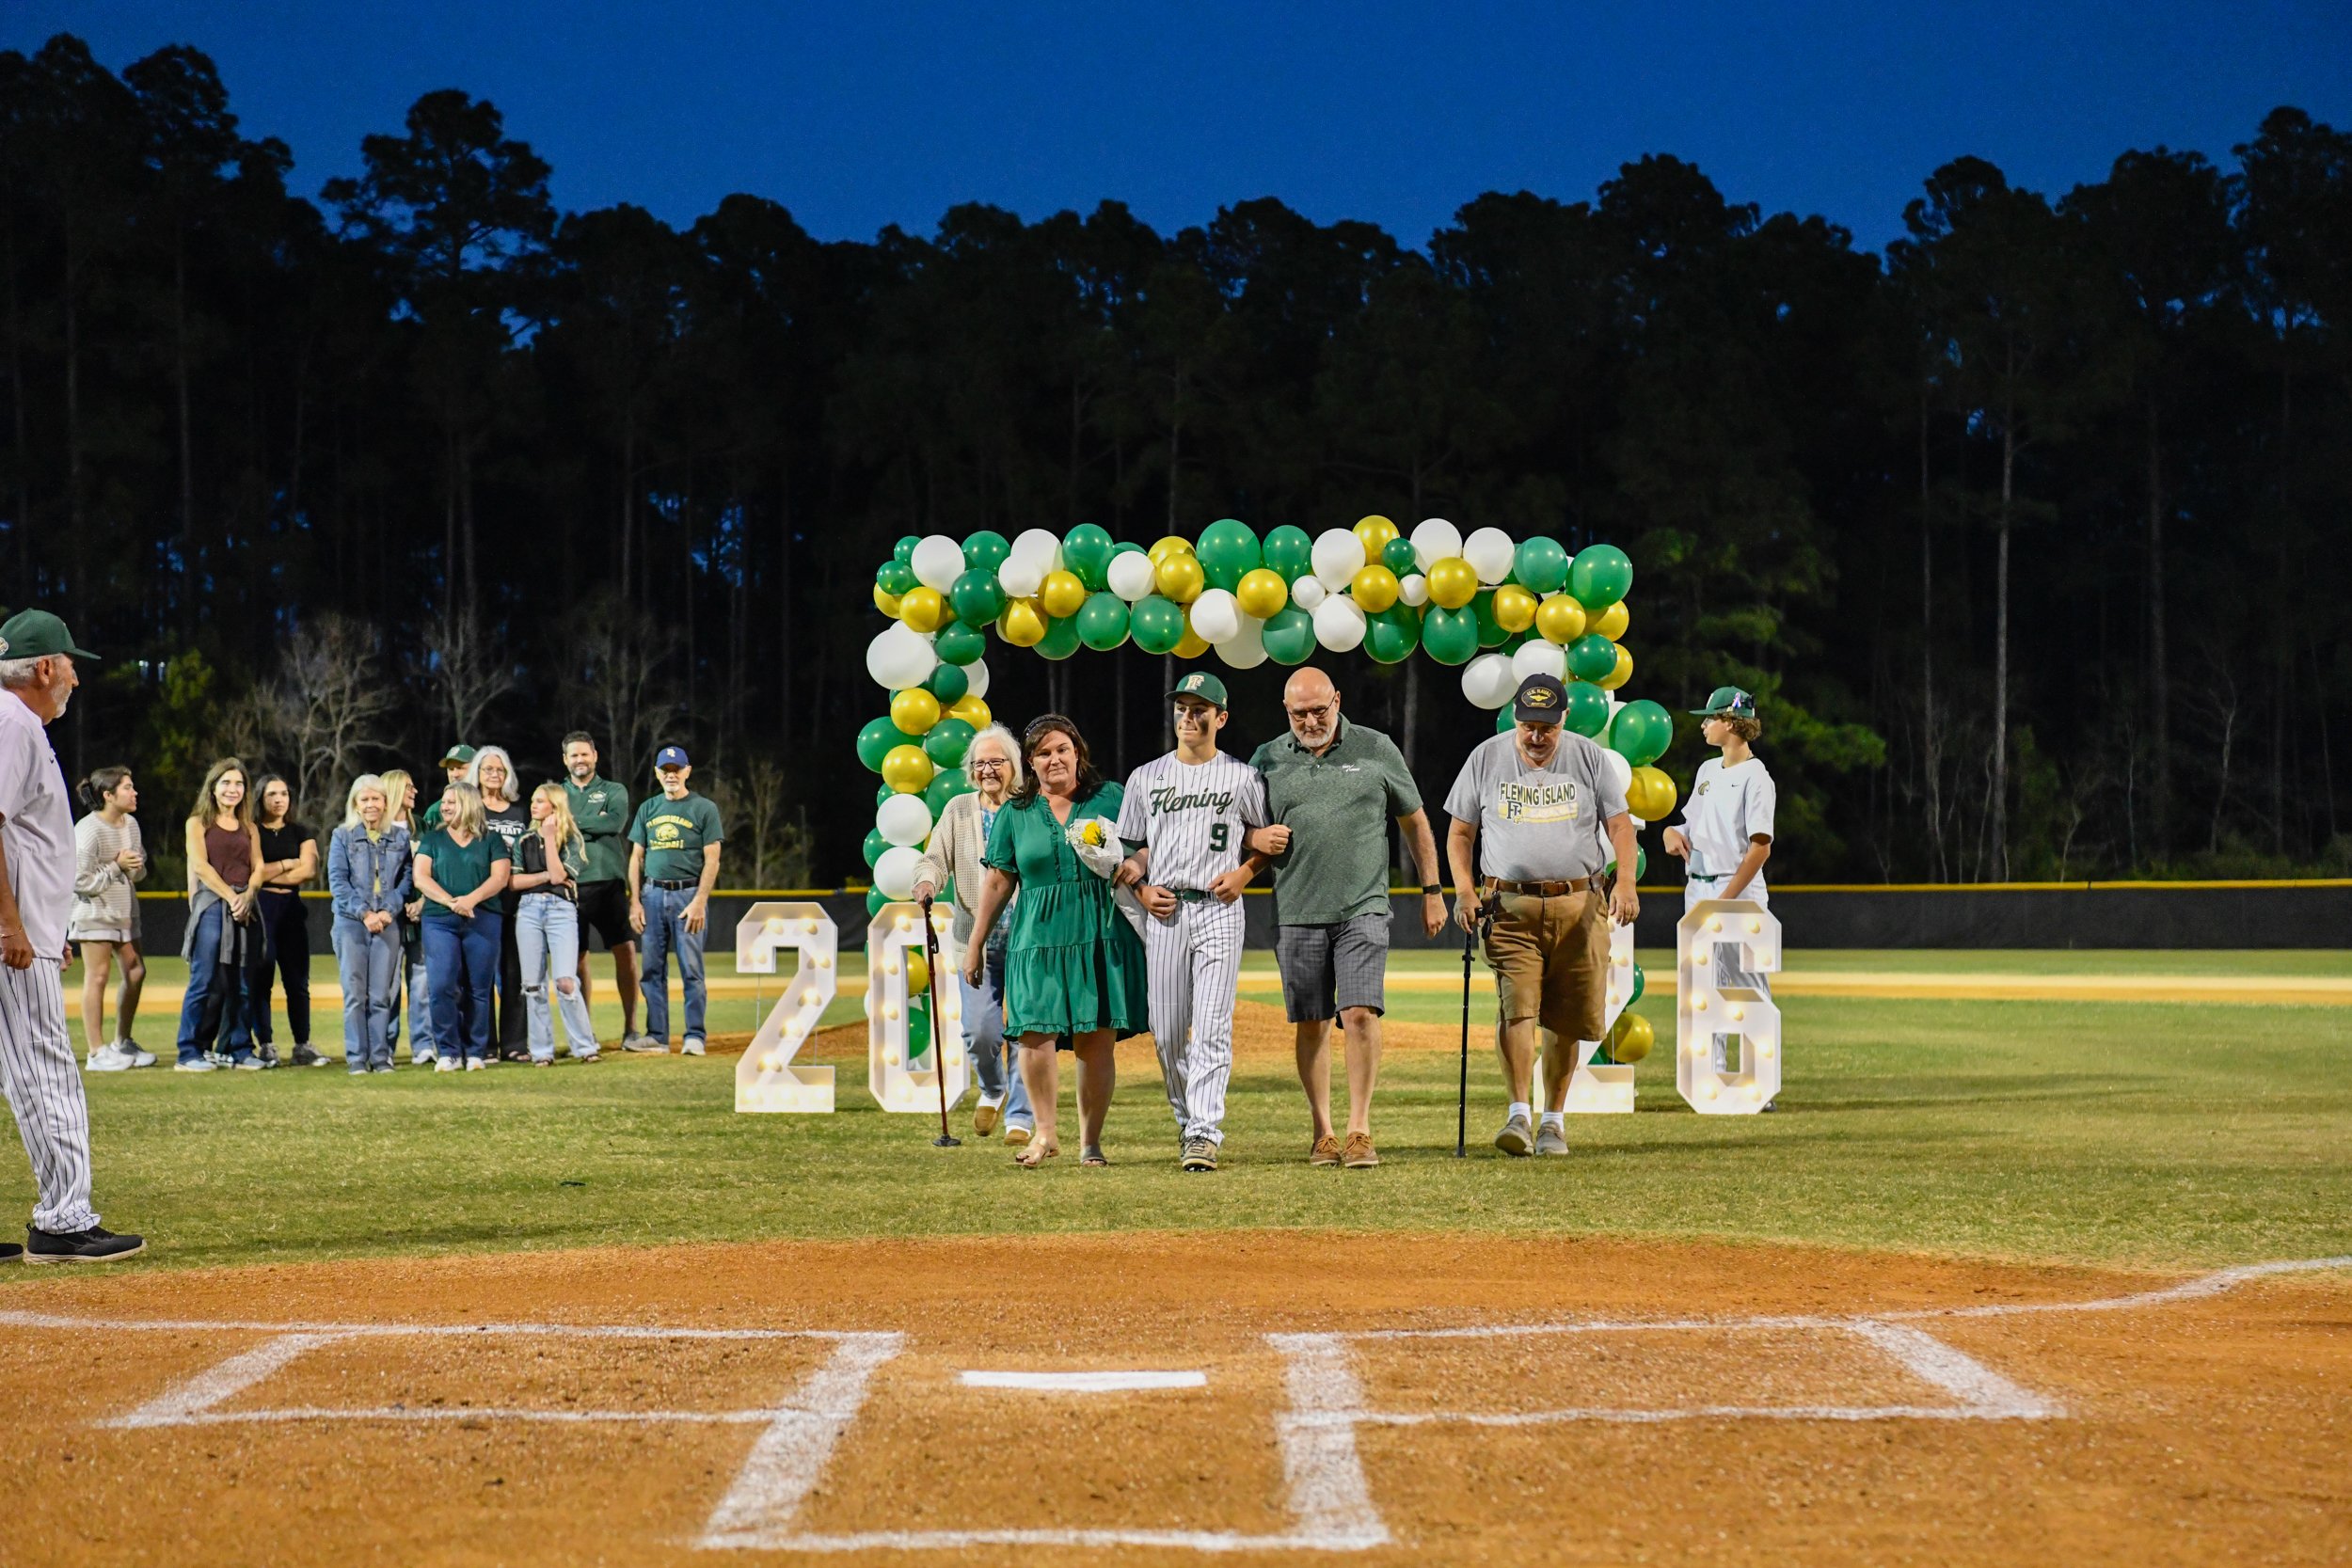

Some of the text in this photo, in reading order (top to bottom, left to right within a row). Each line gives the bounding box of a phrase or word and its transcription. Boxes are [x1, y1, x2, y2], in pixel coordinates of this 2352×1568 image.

[1150, 785, 1233, 817] Fleming
[1499, 783, 1576, 806] FLEMING ISLAND
[1209, 823, 1229, 852] 9
